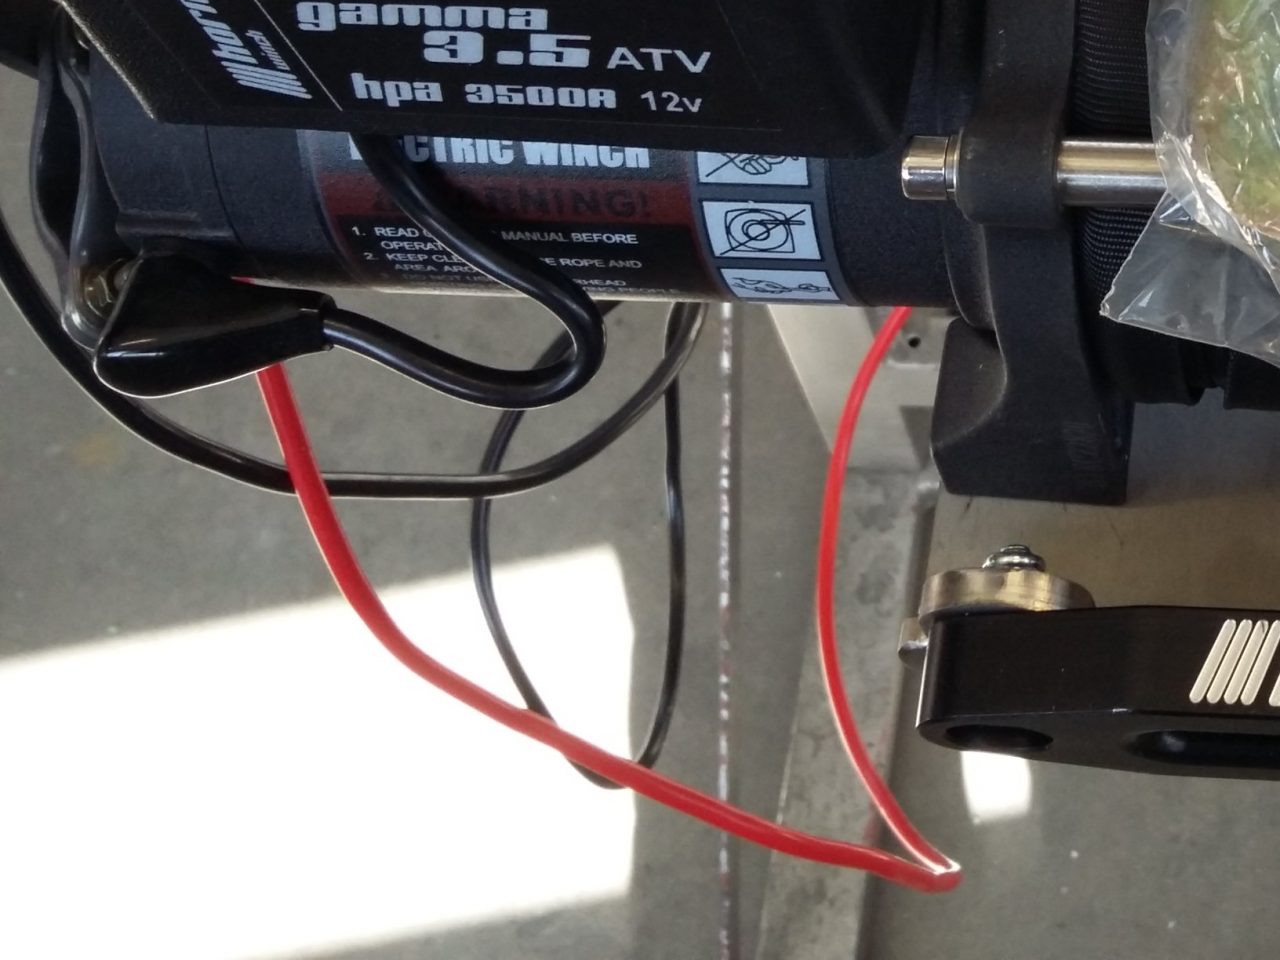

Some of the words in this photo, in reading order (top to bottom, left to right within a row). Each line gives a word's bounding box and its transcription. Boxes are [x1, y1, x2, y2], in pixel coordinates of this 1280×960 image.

[296, 1, 548, 31] gamma
[423, 30, 591, 68] 3.5
[607, 46, 711, 73] ATV
[351, 72, 443, 107] hpa
[374, 226, 419, 238] READ
[501, 230, 569, 242] MANUAL
[571, 232, 639, 244] BEFORE
[381, 240, 446, 252] OPERAT
[386, 253, 428, 262] KEEP
[432, 254, 465, 263] CLE
[559, 258, 606, 268] ROPE
[608, 259, 643, 269] AND
